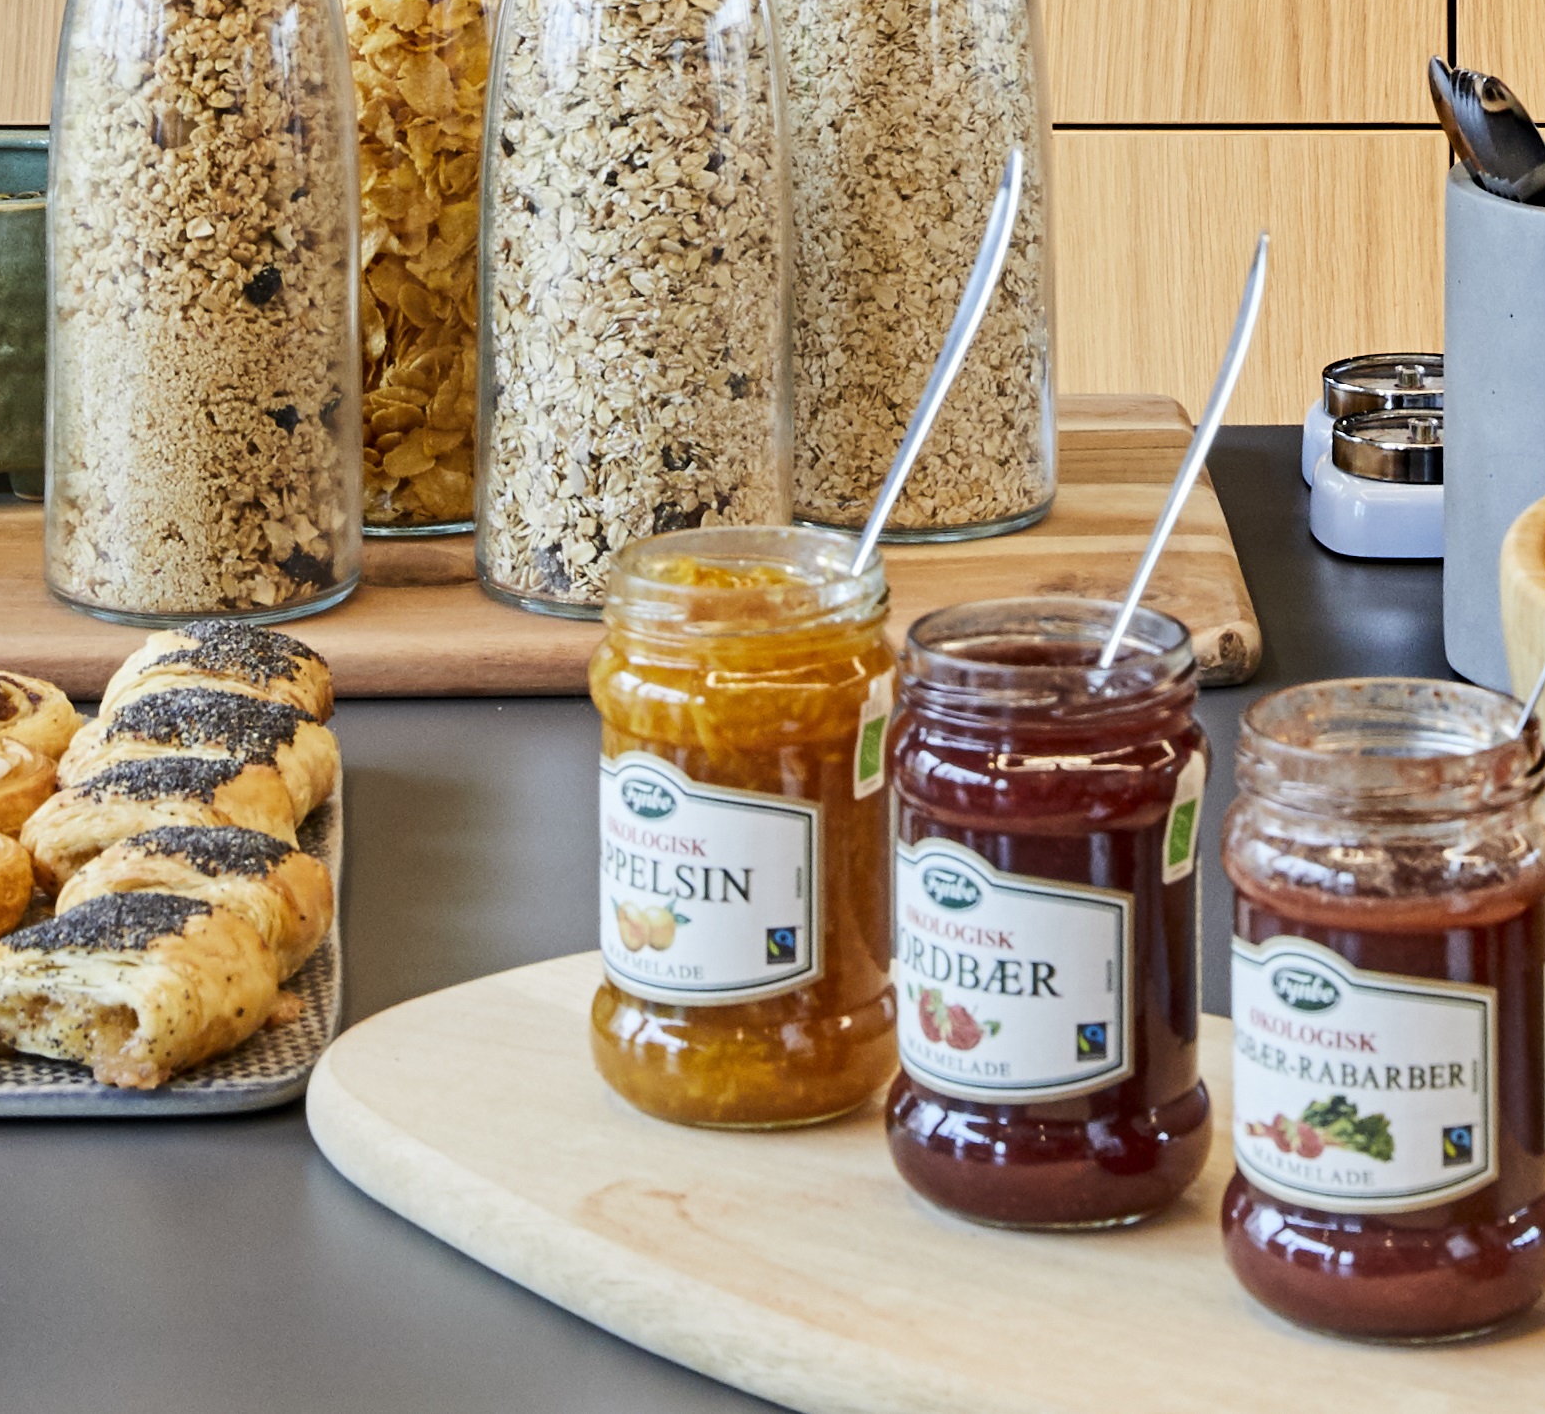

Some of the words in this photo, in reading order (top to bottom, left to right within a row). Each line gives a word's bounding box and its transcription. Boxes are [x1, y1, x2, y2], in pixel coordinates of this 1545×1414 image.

[624, 782, 674, 812] Fynbo
[604, 840, 754, 903] PPELSIN
[925, 872, 980, 903] Fynbo
[1275, 973, 1335, 1005] Fynbo
